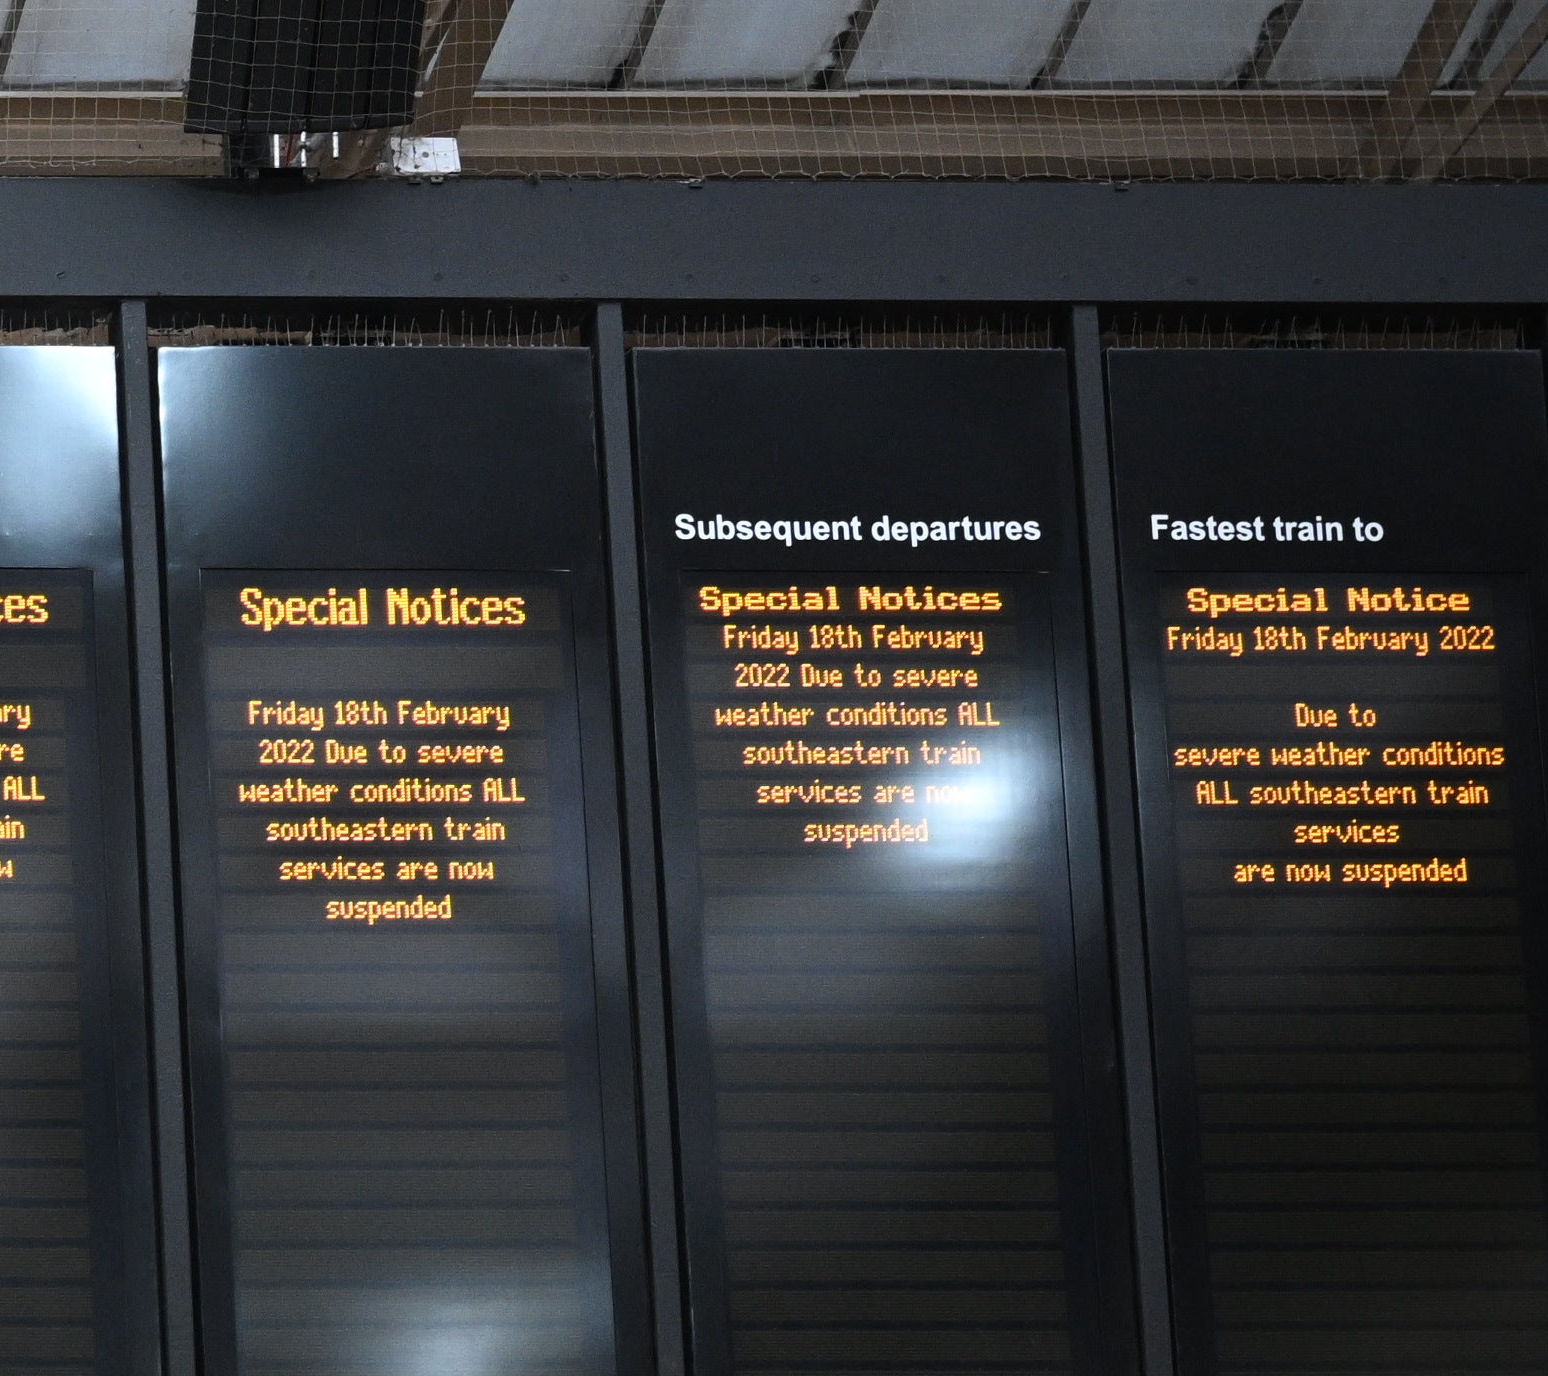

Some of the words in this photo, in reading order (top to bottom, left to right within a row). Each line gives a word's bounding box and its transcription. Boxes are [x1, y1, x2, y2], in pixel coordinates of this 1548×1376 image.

[674, 513, 863, 547] Subsequent
[871, 514, 1041, 548] departures
[1150, 514, 1266, 542] Fastest
[1272, 515, 1344, 542] train
[1352, 516, 1384, 542] to
[239, 587, 369, 633] Special
[385, 587, 526, 627] Notices
[698, 585, 841, 617] Special
[857, 585, 1003, 612] Notices
[1186, 587, 1329, 619] Special
[1346, 587, 1471, 613] Notice
[1166, 625, 1245, 657] Friday
[1252, 625, 1307, 651] 18th
[1316, 625, 1430, 657] February
[1438, 625, 1496, 651] 2022
[1294, 702, 1338, 728] Due
[1347, 702, 1377, 728] to
[1173, 747, 1261, 767] severe
[1270, 741, 1371, 767] weather
[1382, 741, 1505, 767] conditions
[1195, 780, 1239, 805] ALL
[1249, 780, 1417, 805] southeastern
[1426, 779, 1489, 805] train
[1293, 818, 1400, 844] services
[1233, 863, 1276, 883] are
[1285, 863, 1332, 883] now
[1341, 857, 1468, 889] suspended
